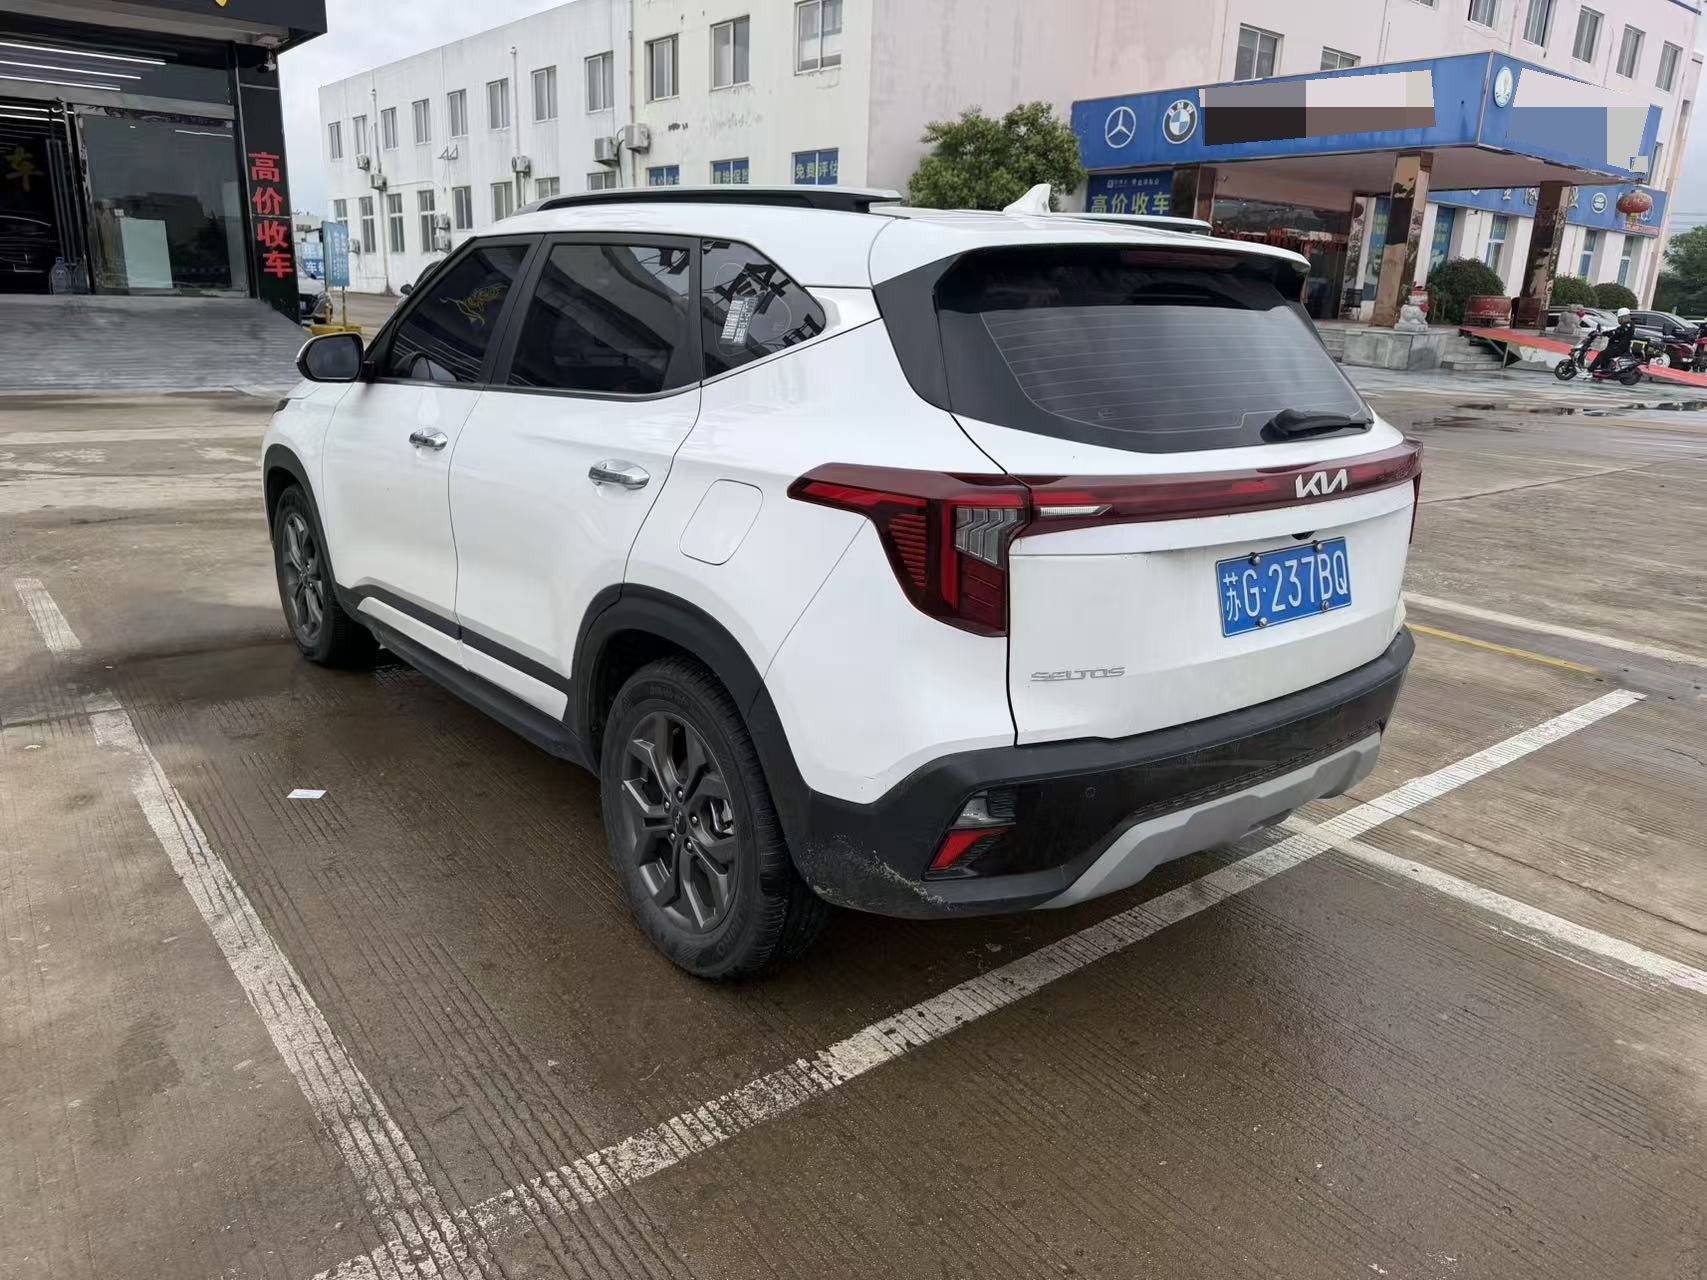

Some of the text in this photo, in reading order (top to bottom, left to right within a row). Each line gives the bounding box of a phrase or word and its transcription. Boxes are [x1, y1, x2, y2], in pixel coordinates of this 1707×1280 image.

[795, 160, 839, 179] 免费评估
[1091, 191, 1171, 214] 高价收车
[248, 151, 294, 278] 高价收车
[1295, 469, 1348, 498] KIA
[1030, 666, 1126, 682] SELTOS
